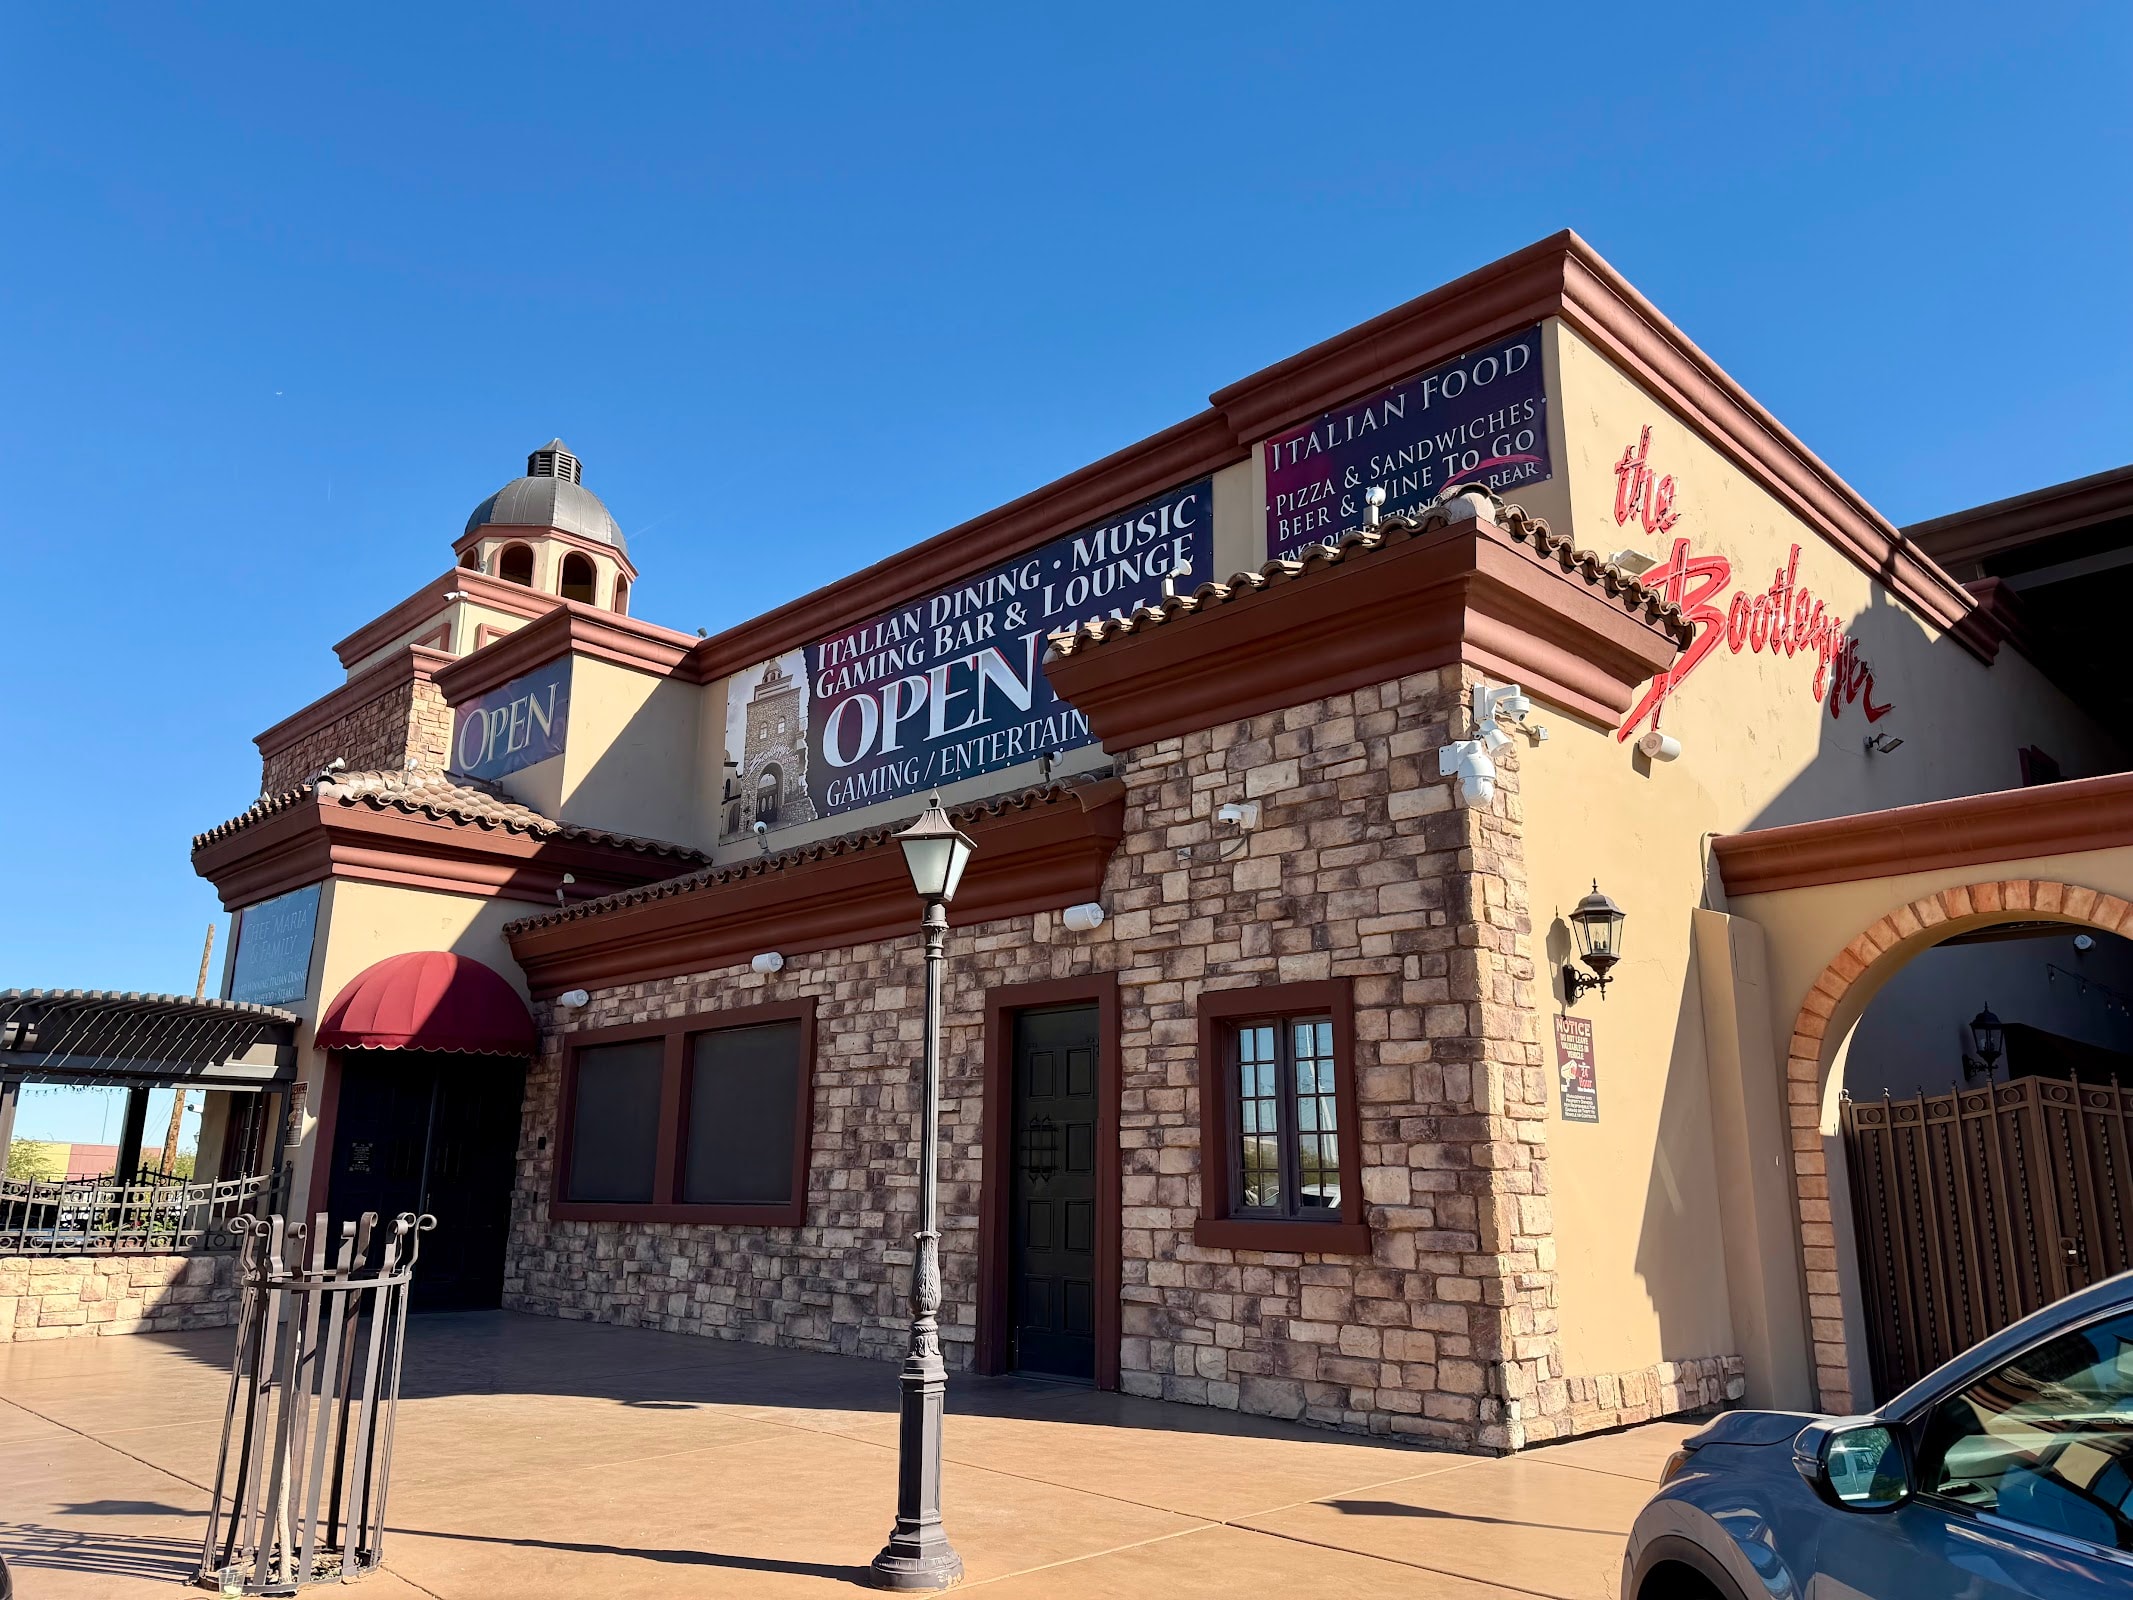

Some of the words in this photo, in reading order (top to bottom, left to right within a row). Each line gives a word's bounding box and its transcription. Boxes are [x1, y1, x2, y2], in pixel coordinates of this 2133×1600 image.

[1272, 394, 1407, 473] ITALIAN
[1420, 343, 1531, 411] FOOD
[1275, 479, 1336, 517] PIZZA
[1344, 465, 1362, 489] &
[1370, 398, 1536, 480] SANDWICHES
[1279, 507, 1332, 542] BEER
[1340, 494, 1358, 518] &
[1443, 448, 1480, 480] TO
[1492, 429, 1536, 461] GO
[1489, 460, 1540, 490] REAR
[1613, 424, 1682, 535] the
[816, 607, 923, 673] ITALIAN
[928, 559, 1042, 629] DINING
[1070, 494, 1197, 573] MUSIC
[816, 637, 926, 699] GAMING
[933, 611, 997, 659] BAR
[1003, 601, 1028, 631] &
[1042, 532, 1195, 618] LOUNGE
[1617, 538, 1896, 744] Bootlegger
[458, 682, 560, 771] OPEN
[822, 628, 1043, 768] OPEN
[826, 755, 920, 808] GAMING
[940, 708, 1091, 777] ENTERTAIN
[244, 921, 271, 944] CHEF
[1556, 1018, 1590, 1037] NOTICE
